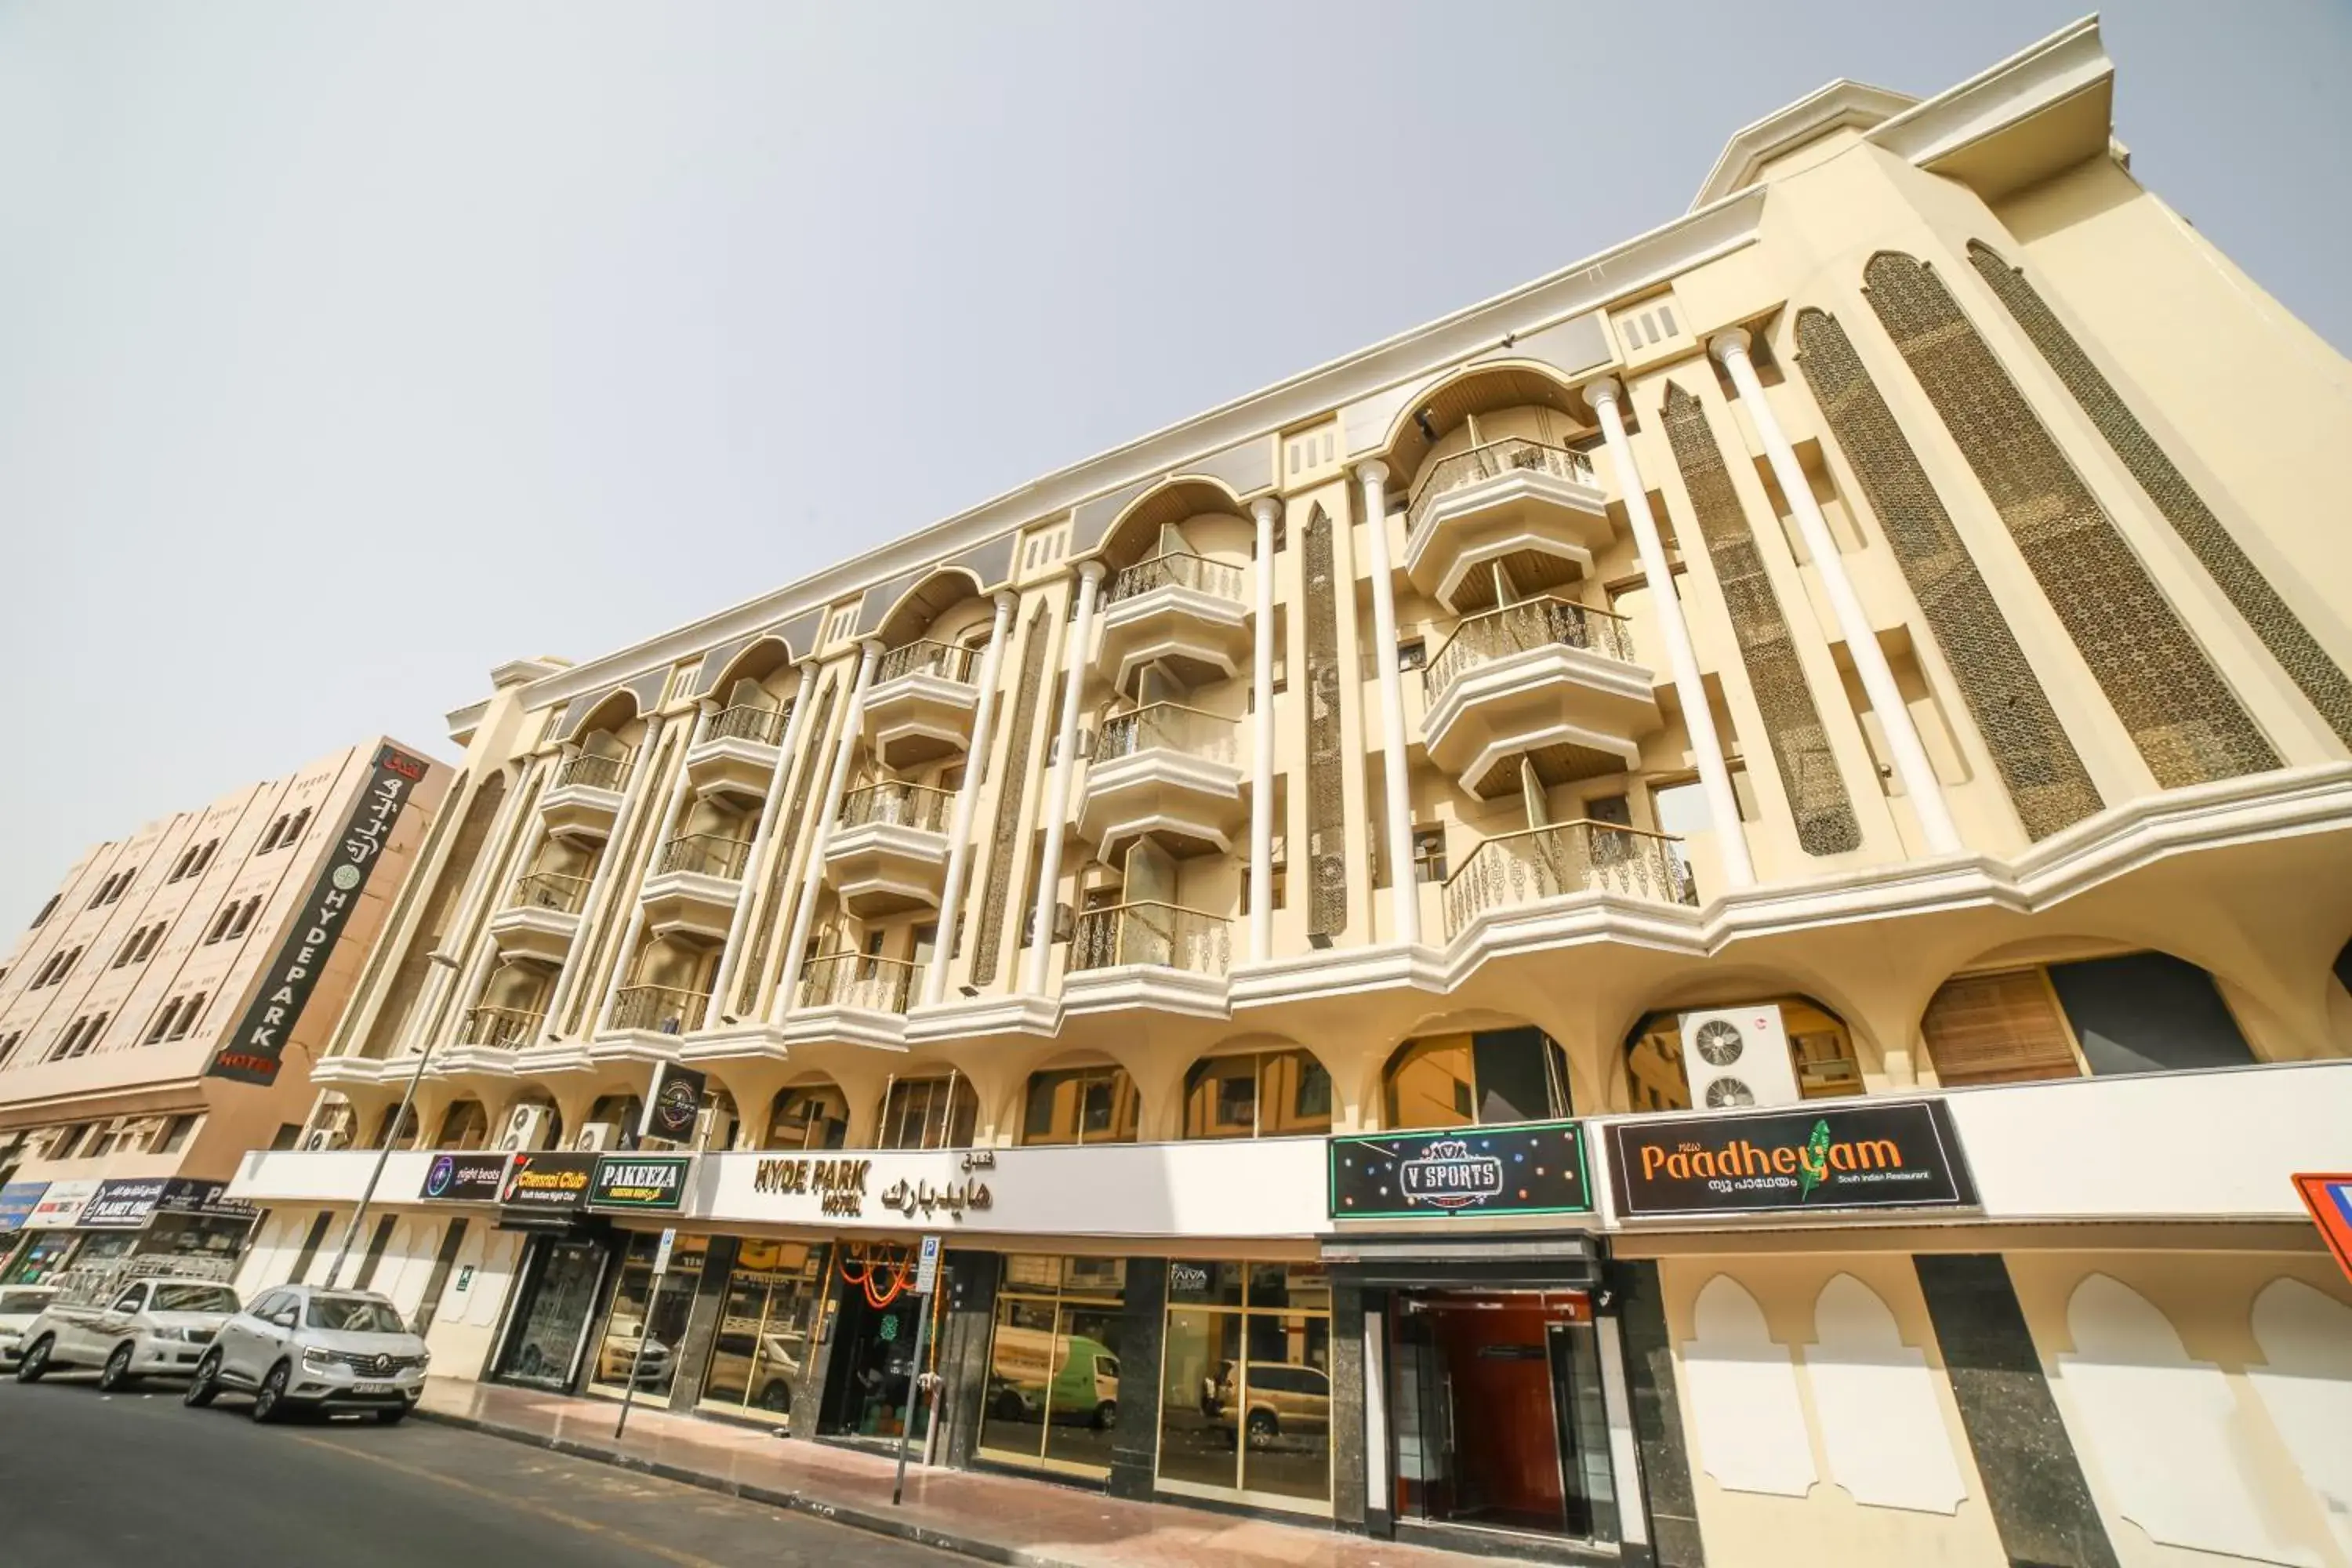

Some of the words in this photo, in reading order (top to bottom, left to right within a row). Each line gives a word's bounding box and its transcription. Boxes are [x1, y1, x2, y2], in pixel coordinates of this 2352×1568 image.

[1407, 1167, 1420, 1189] V
[1425, 1163, 1495, 1189] SPORTS
[1641, 1139, 1904, 1182] Paadheyam
[600, 1165, 677, 1188] PAKEEZA
[753, 1159, 809, 1195] HYDE
[811, 1159, 873, 1196] PARK
